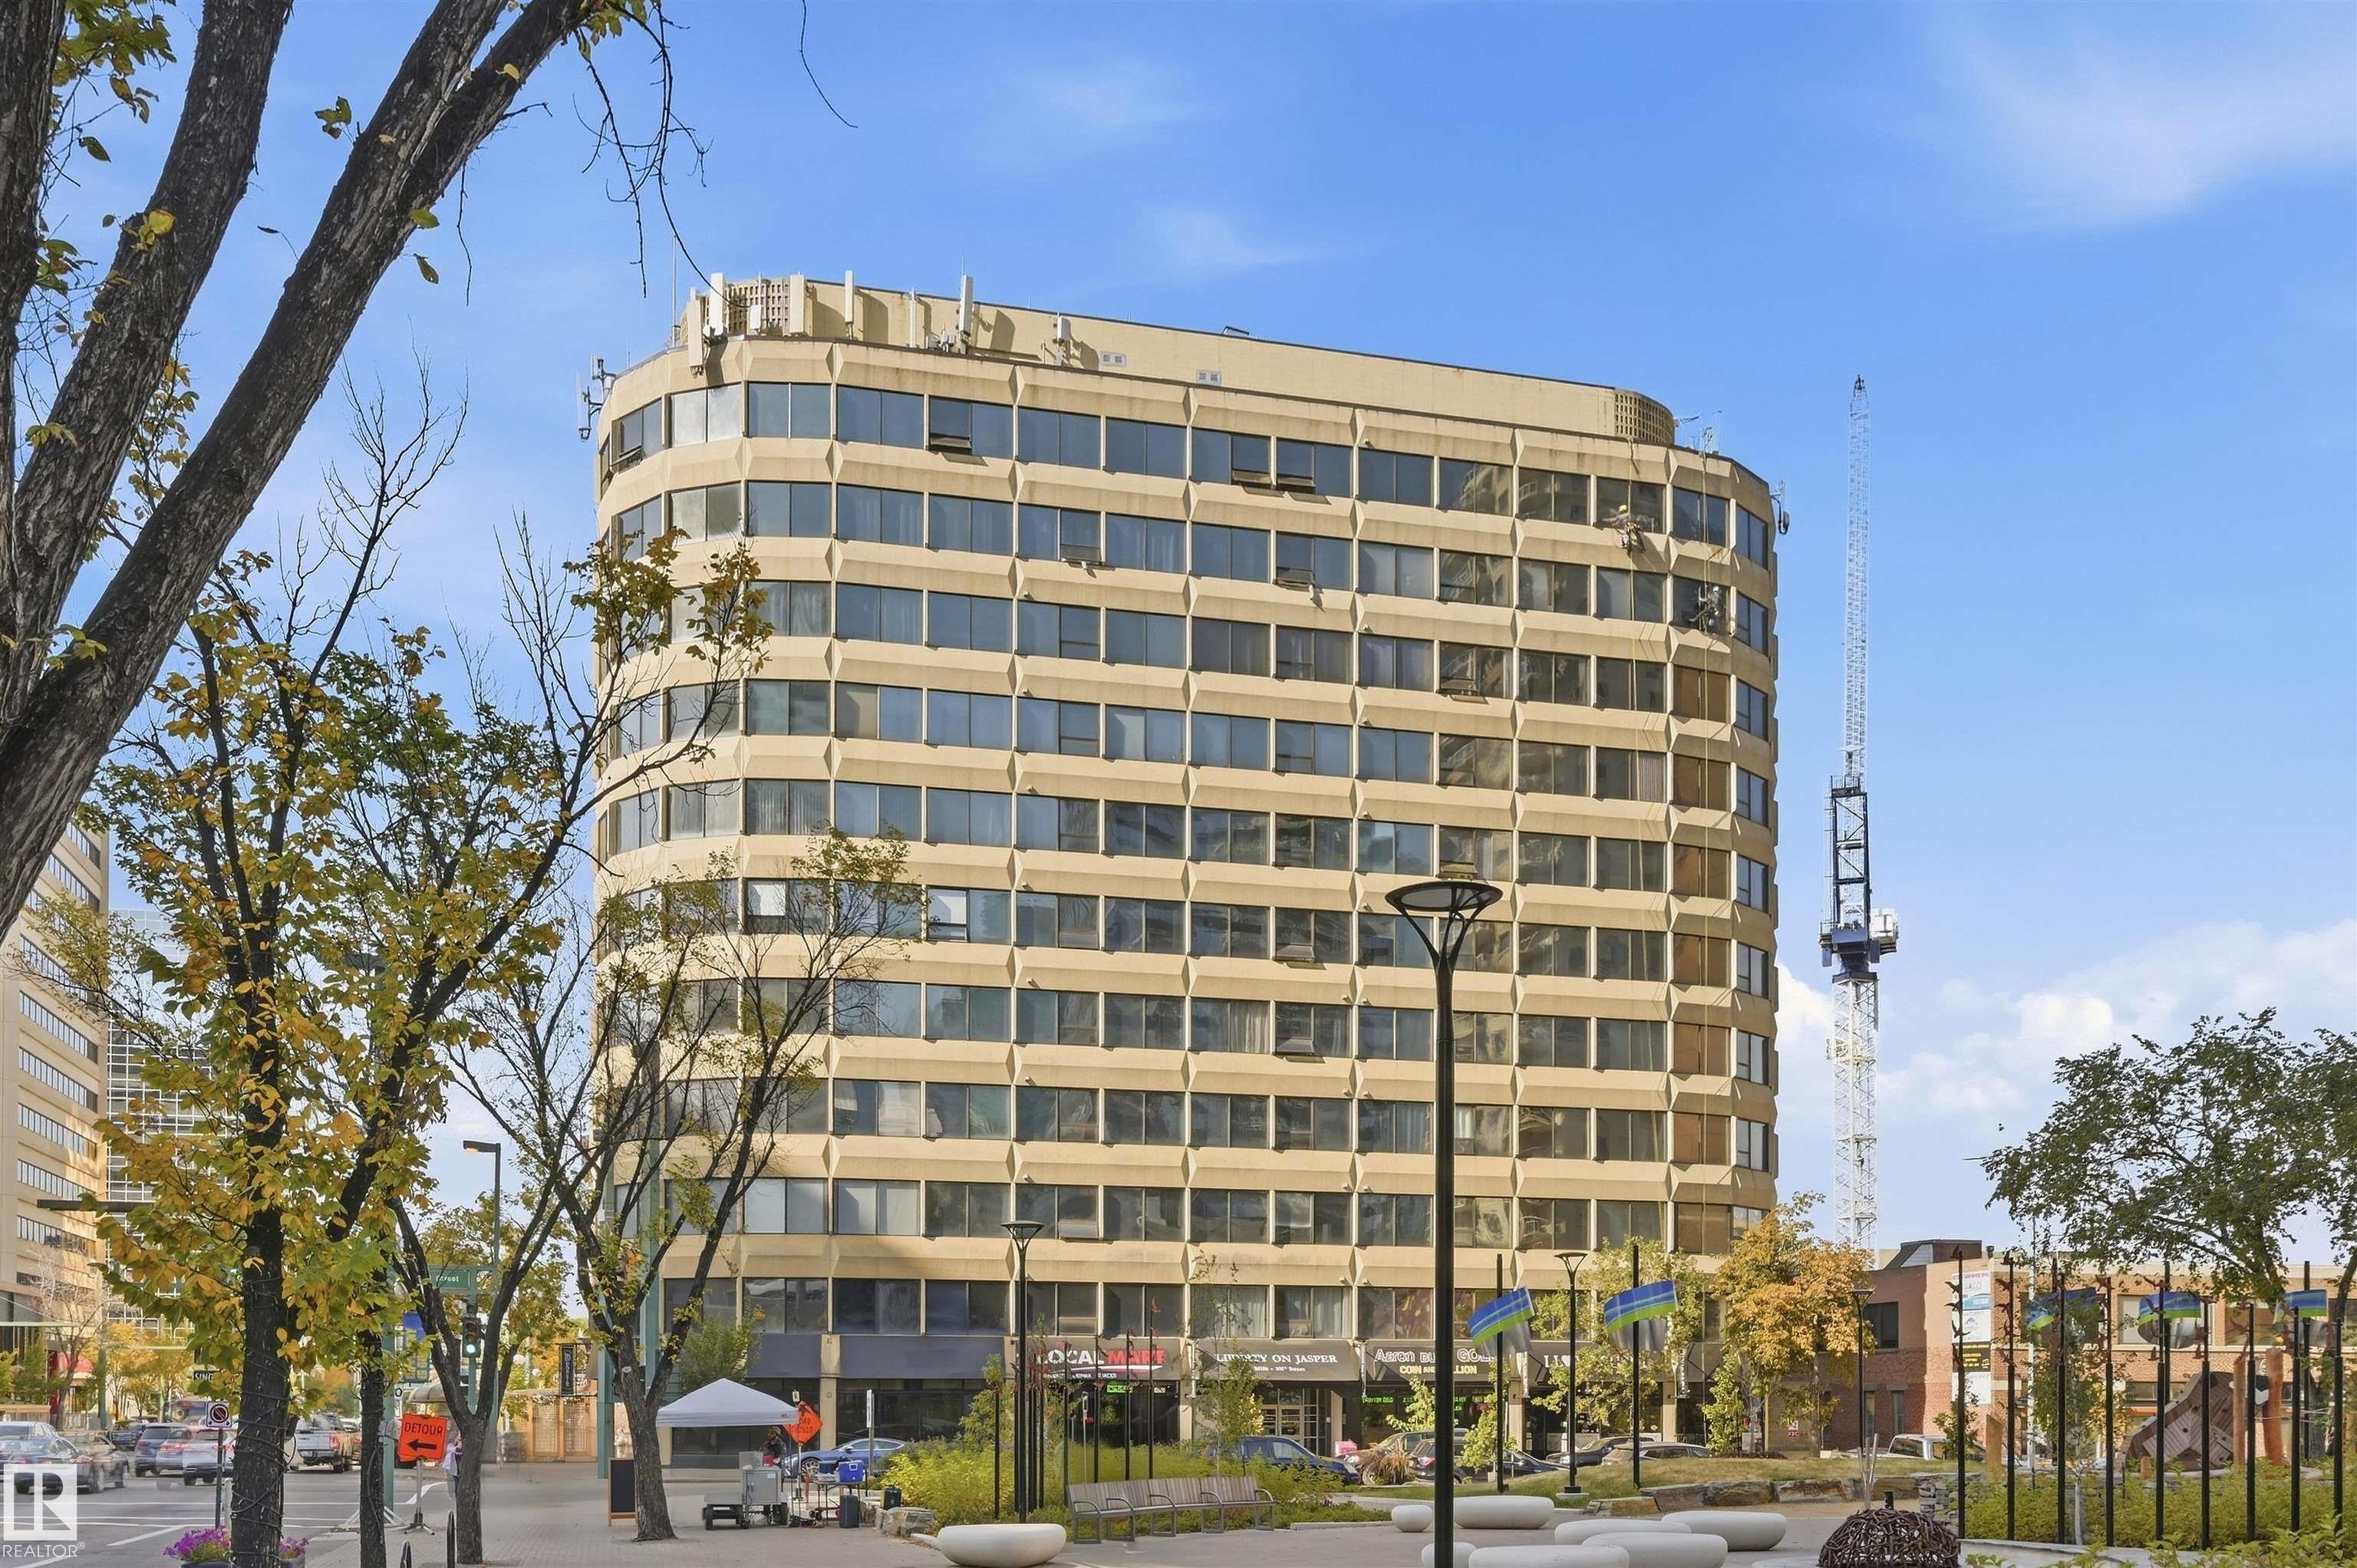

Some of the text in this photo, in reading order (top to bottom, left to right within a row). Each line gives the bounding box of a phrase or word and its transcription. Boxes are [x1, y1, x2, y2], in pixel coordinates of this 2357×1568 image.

[1037, 1349, 1105, 1365] LOCAL
[1271, 1354, 1292, 1363] ON
[1295, 1354, 1338, 1365] JASPER
[1374, 1348, 1416, 1363] Aaron
[1399, 1365, 1422, 1374] COIN
[404, 1421, 443, 1437] DETOUR
